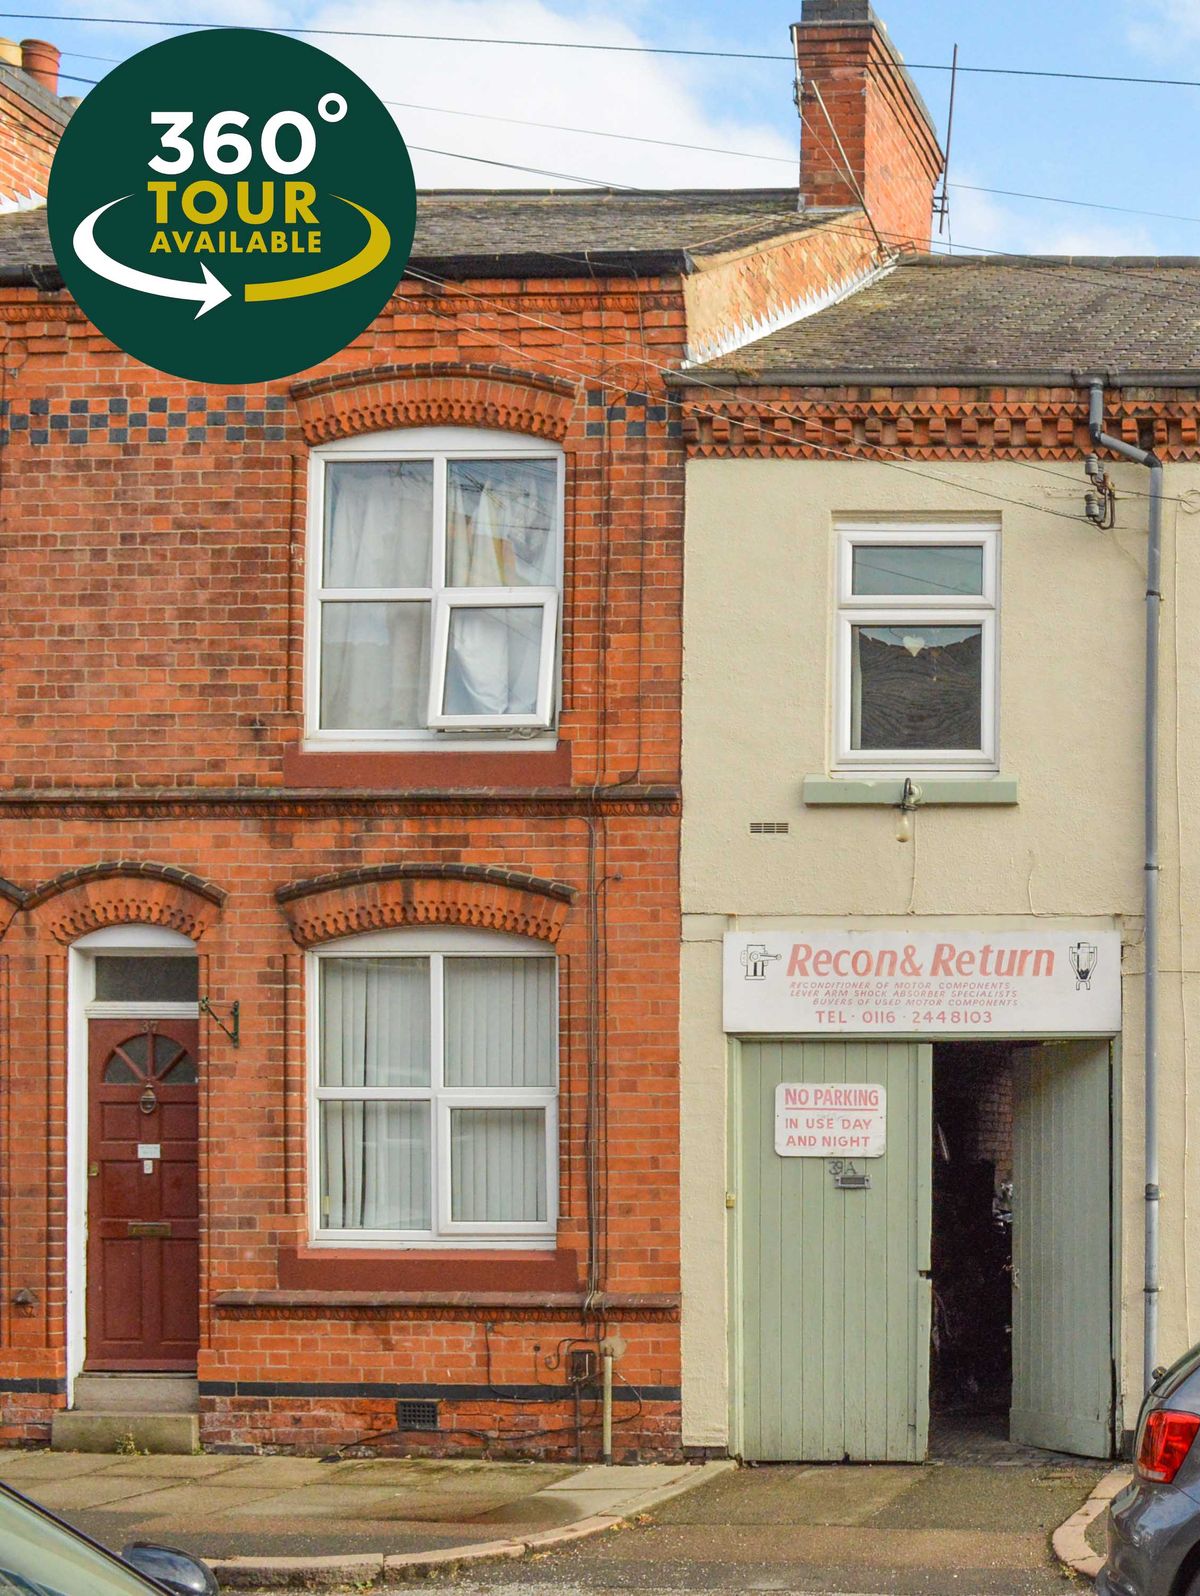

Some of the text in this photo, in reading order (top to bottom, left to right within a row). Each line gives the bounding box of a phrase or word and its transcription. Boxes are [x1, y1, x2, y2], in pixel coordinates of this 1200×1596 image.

[929, 943, 1055, 977] Return
[790, 990, 819, 998] LEVER
[854, 990, 887, 998] SHOCK
[892, 990, 946, 998] ABSORBER
[951, 990, 1018, 998] SPECIALISTS
[947, 999, 1019, 1007] COMPONENTS
[862, 1011, 896, 1024] 0116
[785, 1088, 879, 1106] NO PARKING
[785, 1118, 873, 1130] IN USE DAY
[786, 1135, 871, 1148] AND NIGHT
